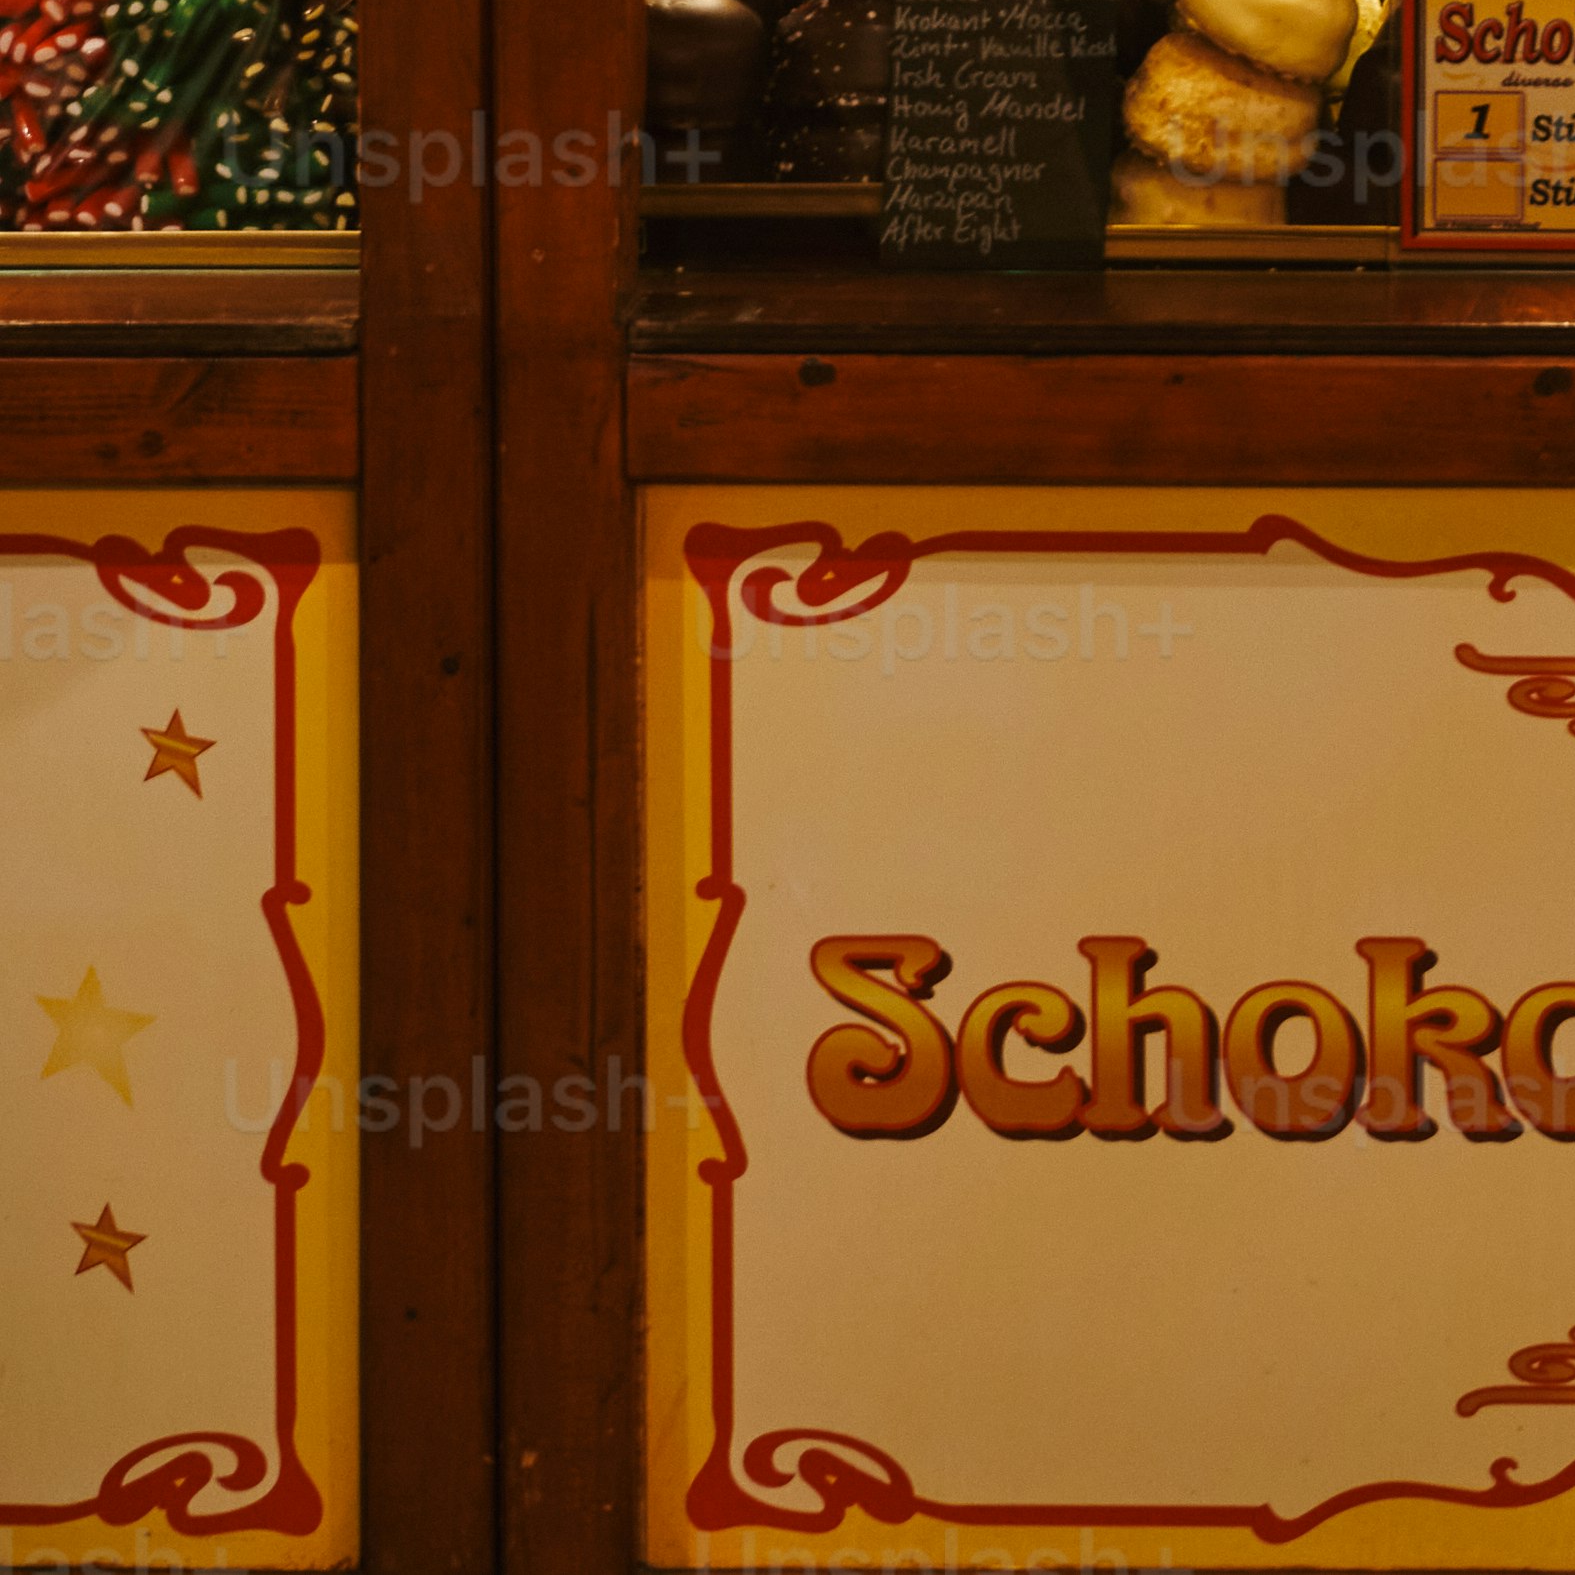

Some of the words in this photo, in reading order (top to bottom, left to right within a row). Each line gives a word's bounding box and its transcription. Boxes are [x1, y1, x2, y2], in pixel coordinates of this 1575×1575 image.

[1501, 70, 1575, 88] diverse
[980, 91, 1086, 120] Mandel
[1463, 103, 1492, 140] 1
[891, 126, 1017, 157] Karamell
[886, 155, 1047, 193] Champagner
